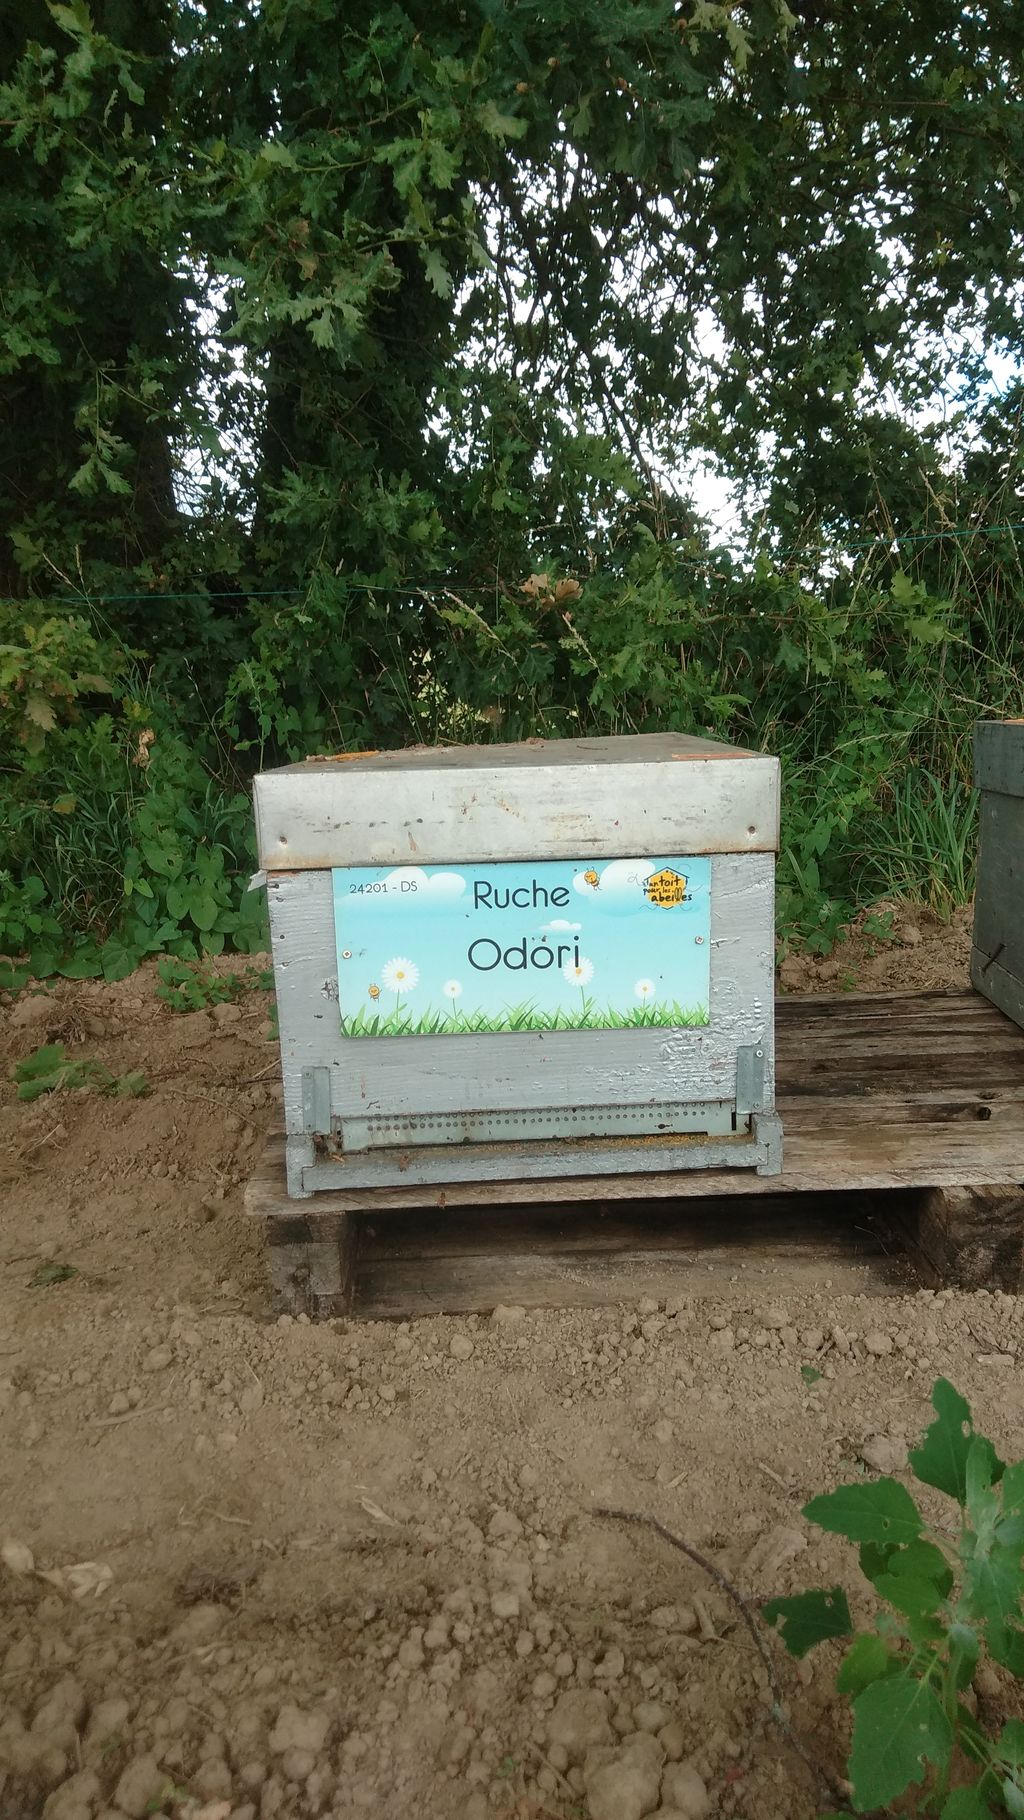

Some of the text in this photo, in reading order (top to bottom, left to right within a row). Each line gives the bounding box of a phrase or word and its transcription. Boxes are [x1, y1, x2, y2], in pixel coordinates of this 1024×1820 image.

[349, 883, 388, 895] 24201
[400, 880, 418, 892] DS
[658, 875, 681, 887] toit
[474, 879, 570, 909] Ruche
[651, 887, 692, 902] abeilles
[468, 935, 580, 971] Odori
